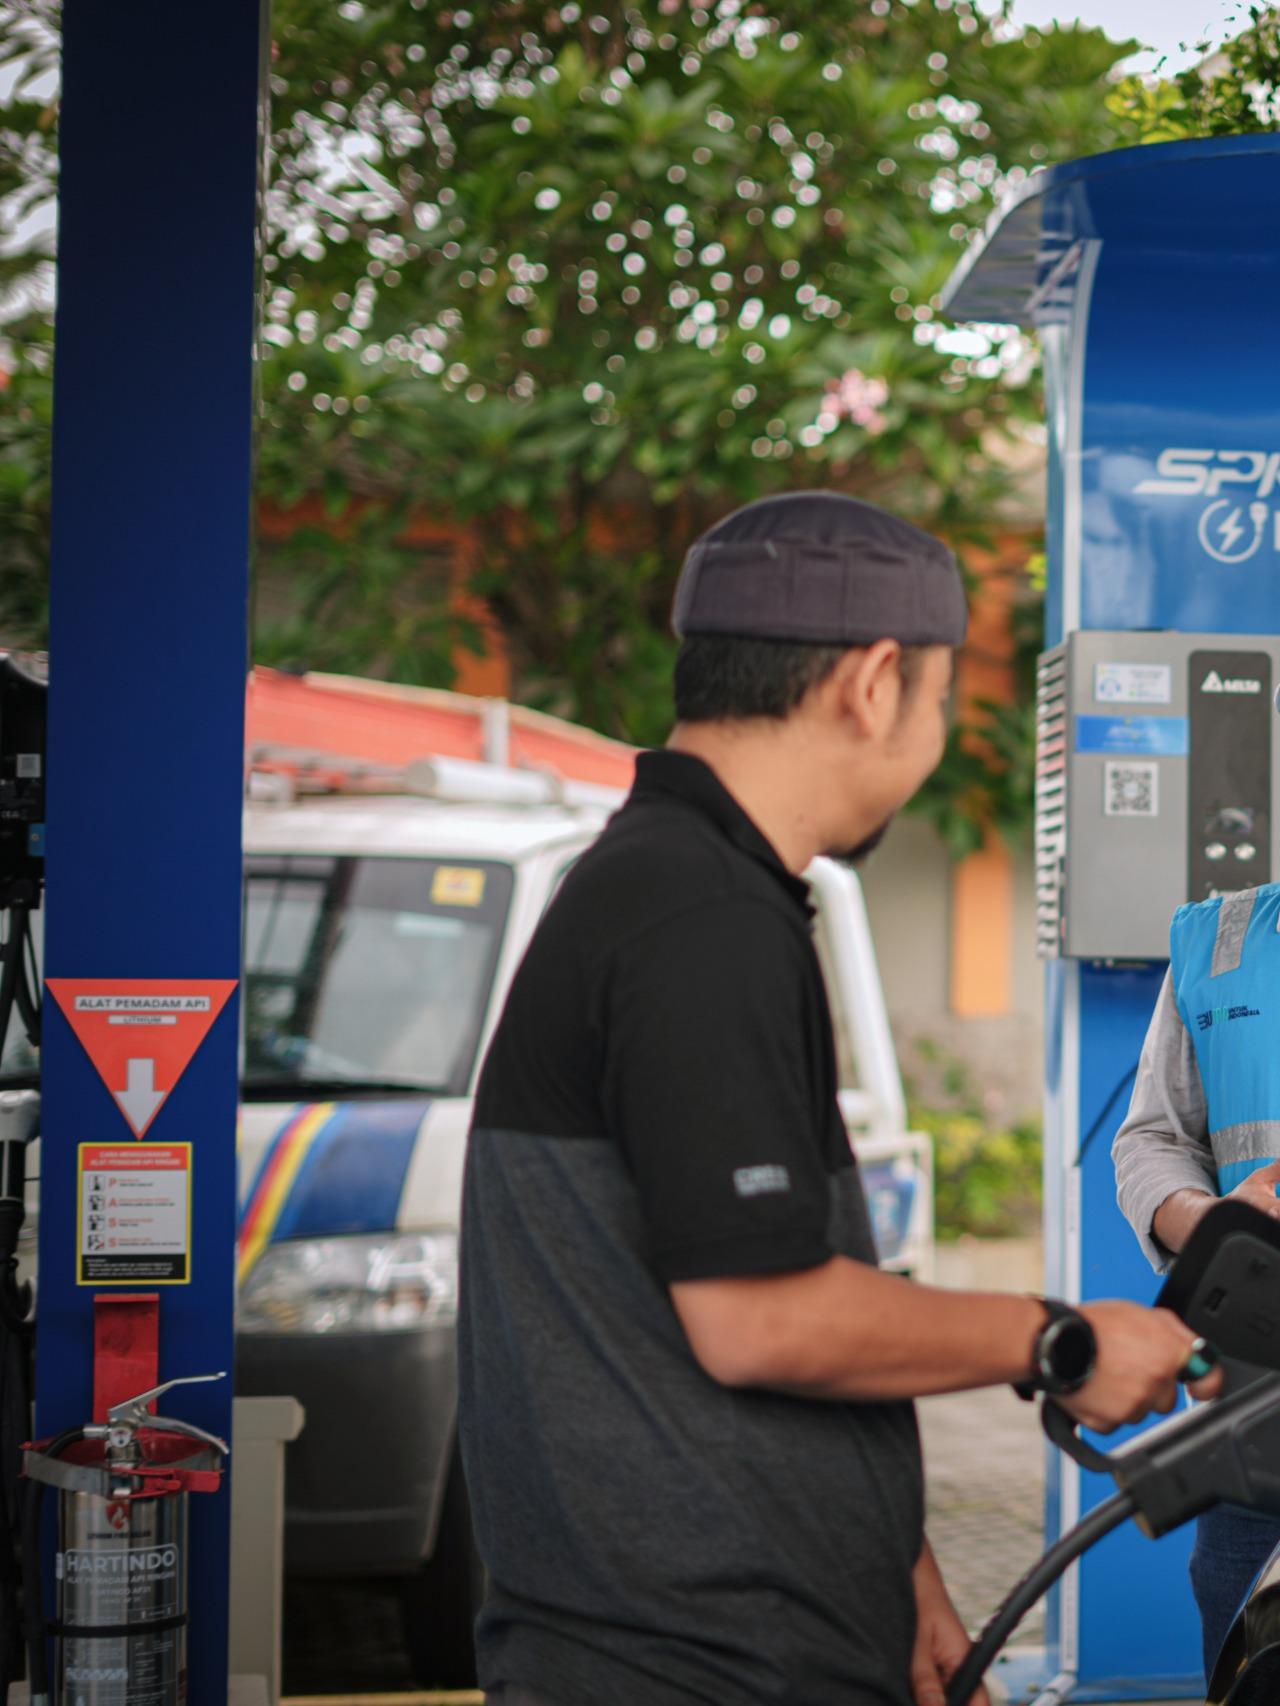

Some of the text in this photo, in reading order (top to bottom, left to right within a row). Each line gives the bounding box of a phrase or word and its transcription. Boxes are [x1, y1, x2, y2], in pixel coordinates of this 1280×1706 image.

[79, 998, 206, 1008] ALAT PEMADAM API
[67, 1550, 175, 1572] HARTINDO
